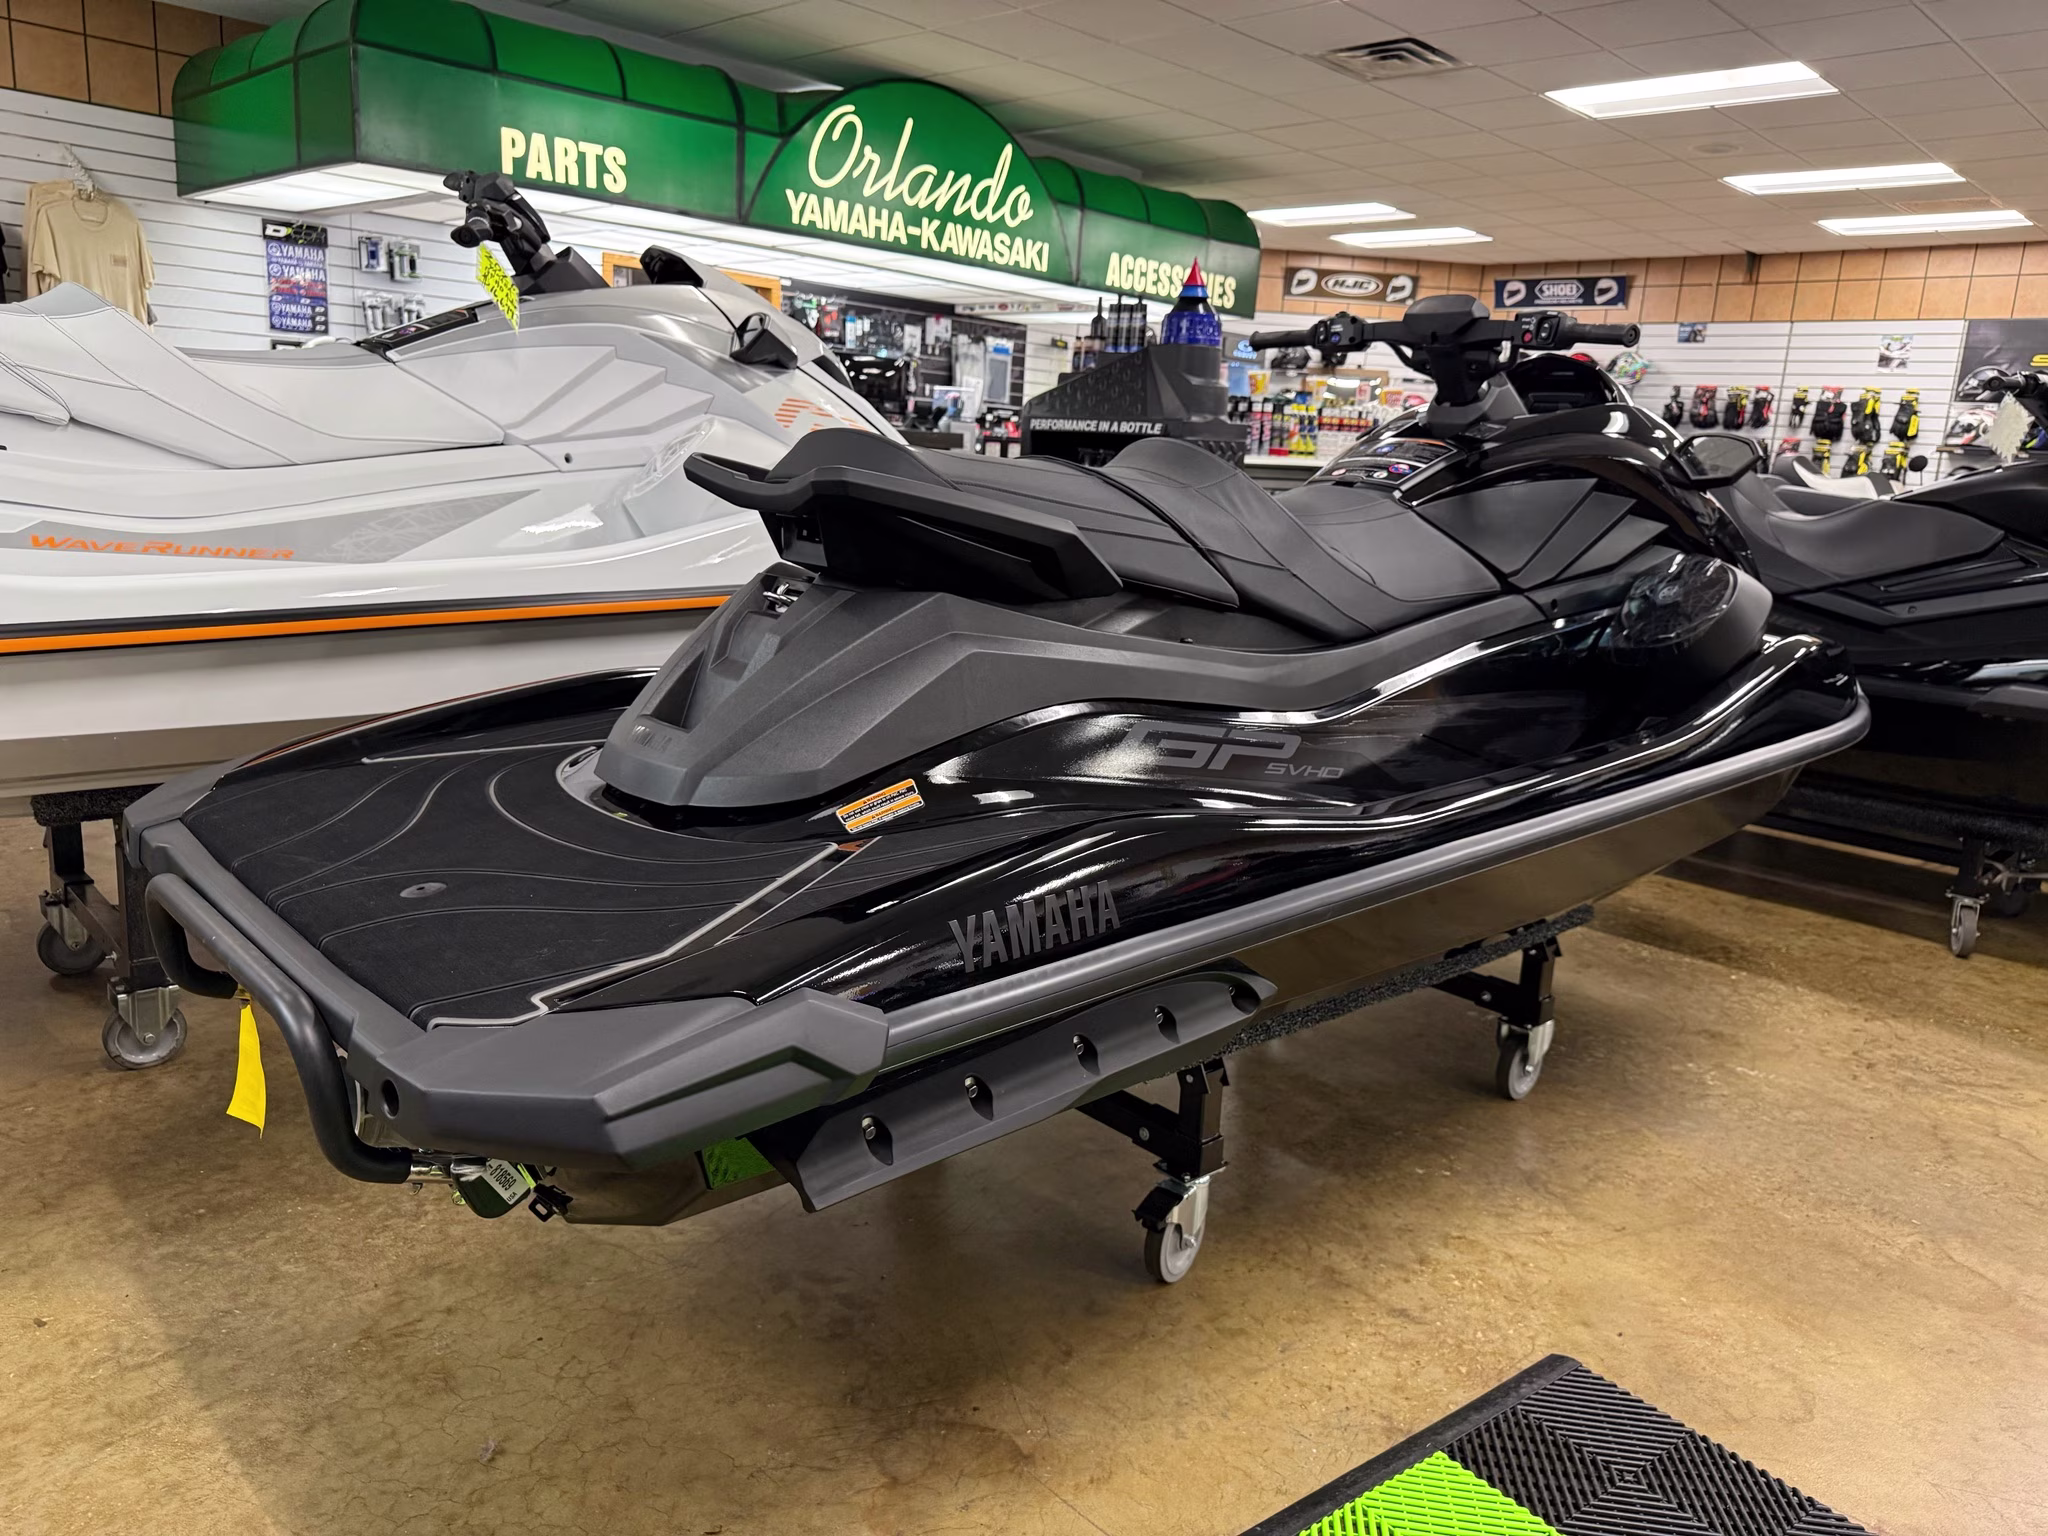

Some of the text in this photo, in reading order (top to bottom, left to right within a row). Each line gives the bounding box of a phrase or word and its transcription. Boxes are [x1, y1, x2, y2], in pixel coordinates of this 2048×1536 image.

[500, 126, 627, 194] PARTS
[808, 104, 1034, 228] Orlando
[785, 188, 1050, 273] YAMAHA-KAWASAKI
[280, 245, 325, 261] YAMAHA
[281, 265, 326, 282] YAMAHA
[1105, 252, 1237, 309] ACCESSIES
[1332, 279, 1372, 291] HJC
[1541, 284, 1577, 297] SHOEI
[1030, 418, 1163, 435] PERFORMANCE IN A BOTTLE
[948, 880, 1121, 973] YAMAHA
[506, 1191, 518, 1203] USA
